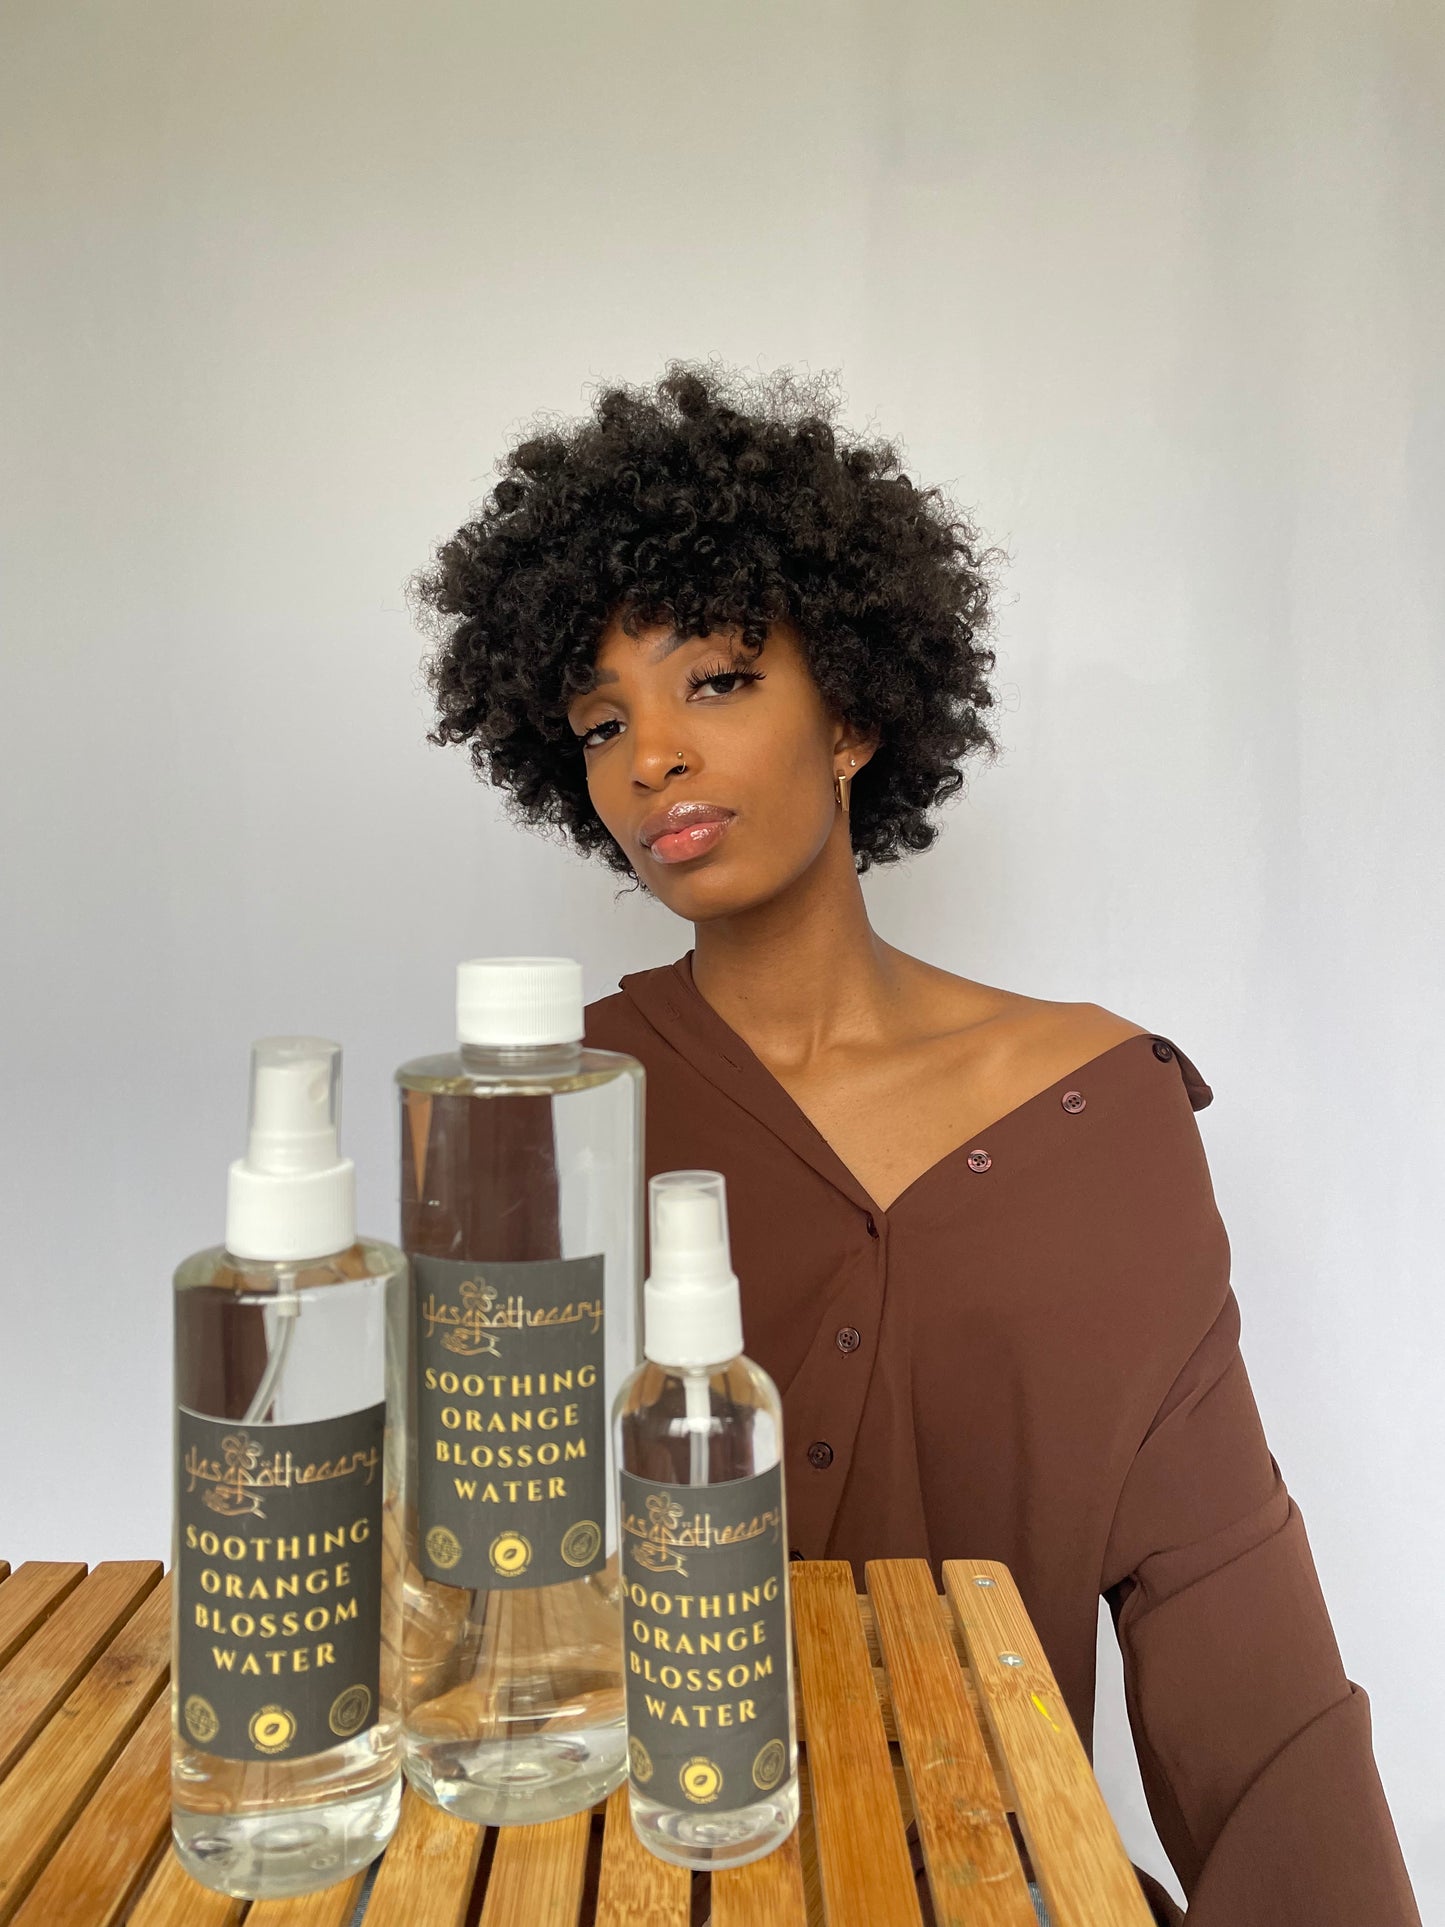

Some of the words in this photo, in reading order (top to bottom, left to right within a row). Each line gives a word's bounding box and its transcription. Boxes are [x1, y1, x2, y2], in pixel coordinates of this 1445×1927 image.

[425, 1366, 597, 1398] SOOTHING
[440, 1404, 580, 1433] ORANGE
[435, 1438, 588, 1469] BLOSSOM
[453, 1476, 567, 1504] WATER
[186, 1518, 370, 1563] SOOTHING
[199, 1562, 351, 1600] ORANGE
[194, 1597, 359, 1639] BLOSSOM
[632, 1619, 766, 1656] ORANGE
[211, 1643, 336, 1676] WATER
[629, 1651, 773, 1692] BLOSSOM
[644, 1695, 757, 1729] WATER
